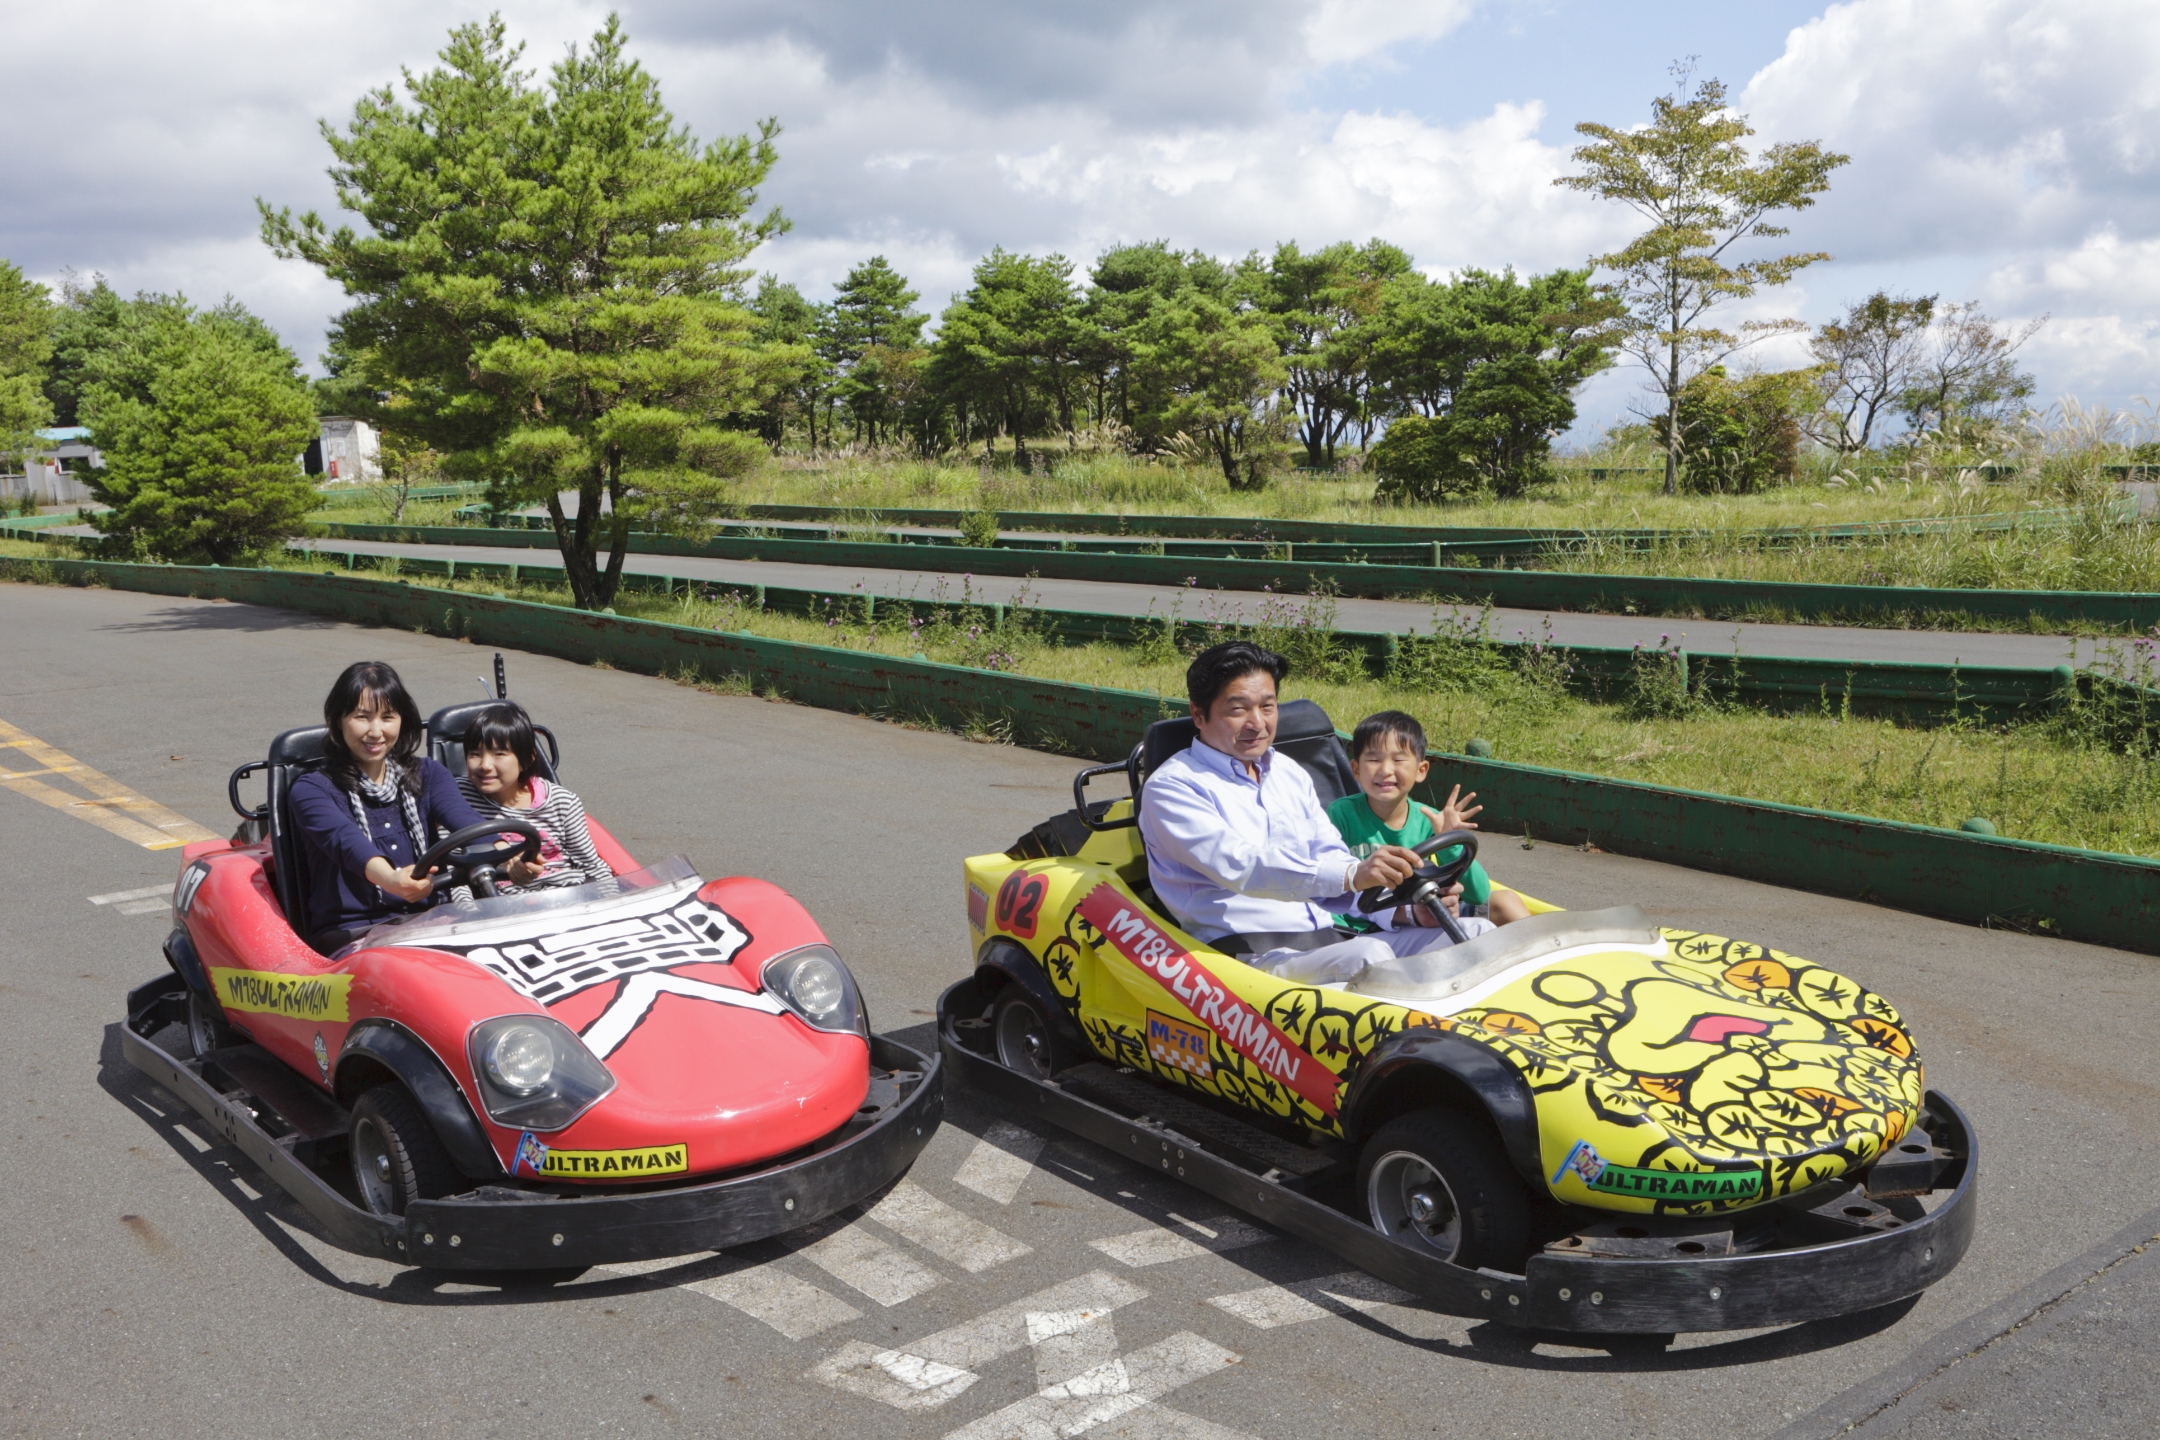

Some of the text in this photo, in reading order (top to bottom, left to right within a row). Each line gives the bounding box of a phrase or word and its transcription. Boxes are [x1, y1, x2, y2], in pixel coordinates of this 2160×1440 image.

[176, 865, 206, 911] 07
[999, 876, 1042, 930] 02
[1150, 1019, 1204, 1055] M-78
[542, 1150, 682, 1171] ULTRAMAN
[1574, 1151, 1599, 1178] M78
[1596, 1171, 1756, 1195] ULTRAMAN
